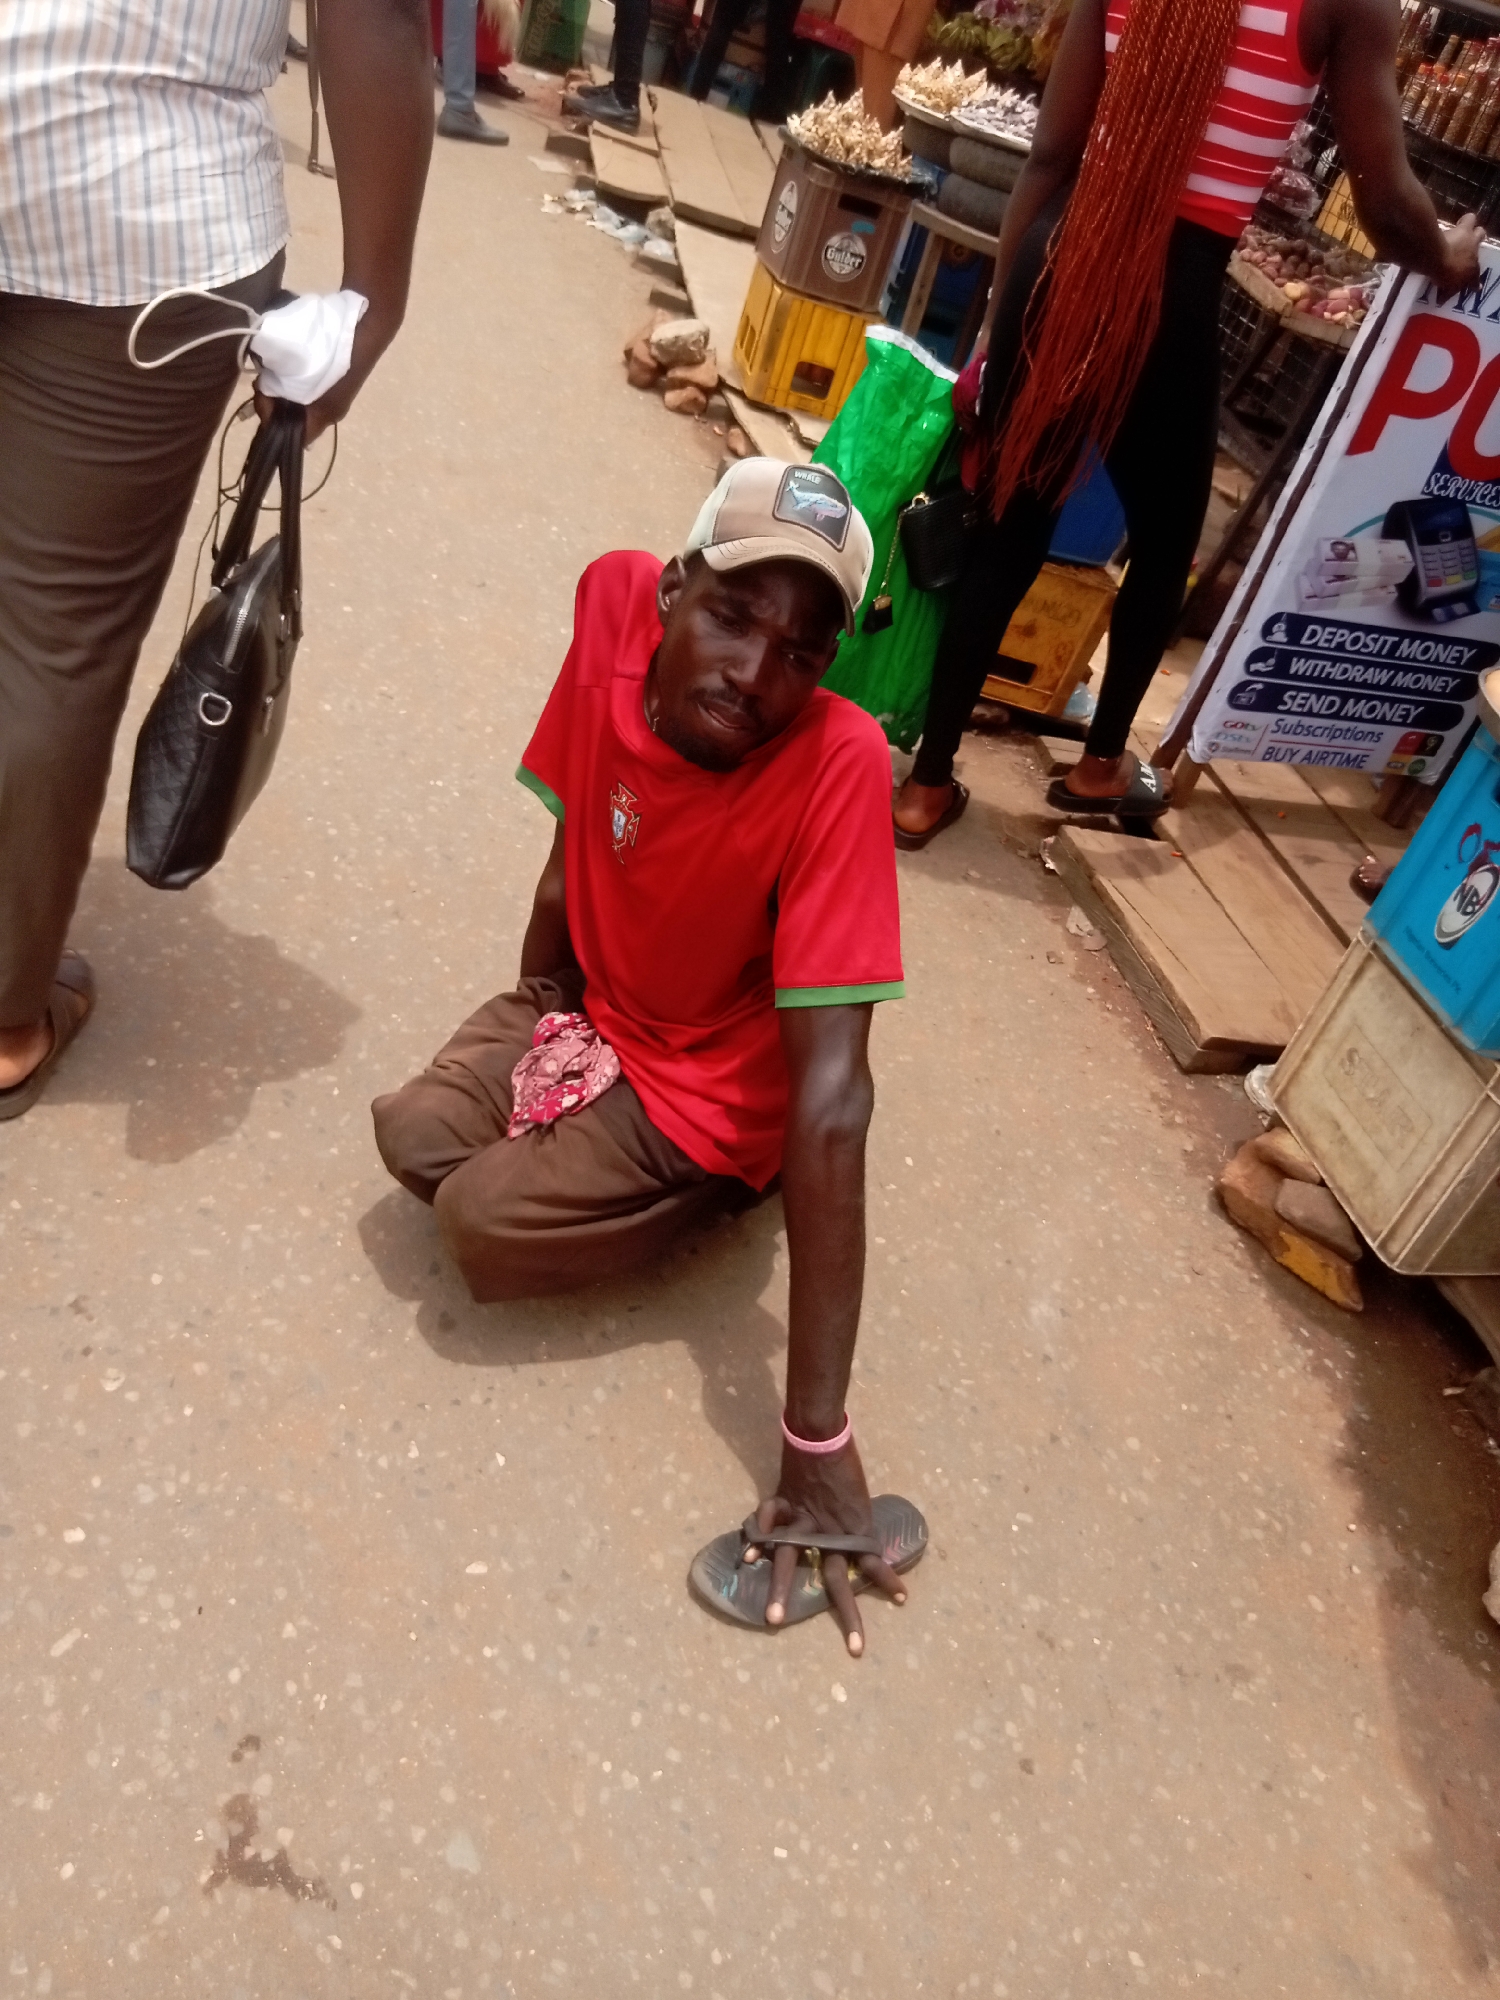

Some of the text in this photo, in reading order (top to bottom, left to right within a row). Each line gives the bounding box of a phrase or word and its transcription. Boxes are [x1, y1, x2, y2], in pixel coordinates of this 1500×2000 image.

[826, 247, 862, 269] Gulder
[794, 470, 822, 485] WHALE
[1300, 624, 1478, 666] DEPOSIT MONEY
[1289, 657, 1461, 693] WITHDRAW MONEY
[1278, 690, 1425, 724] SEND MONEY
[1270, 718, 1384, 743] Subscriptions
[1262, 746, 1300, 764] BUY
[1302, 749, 1370, 769] AIRTIME
